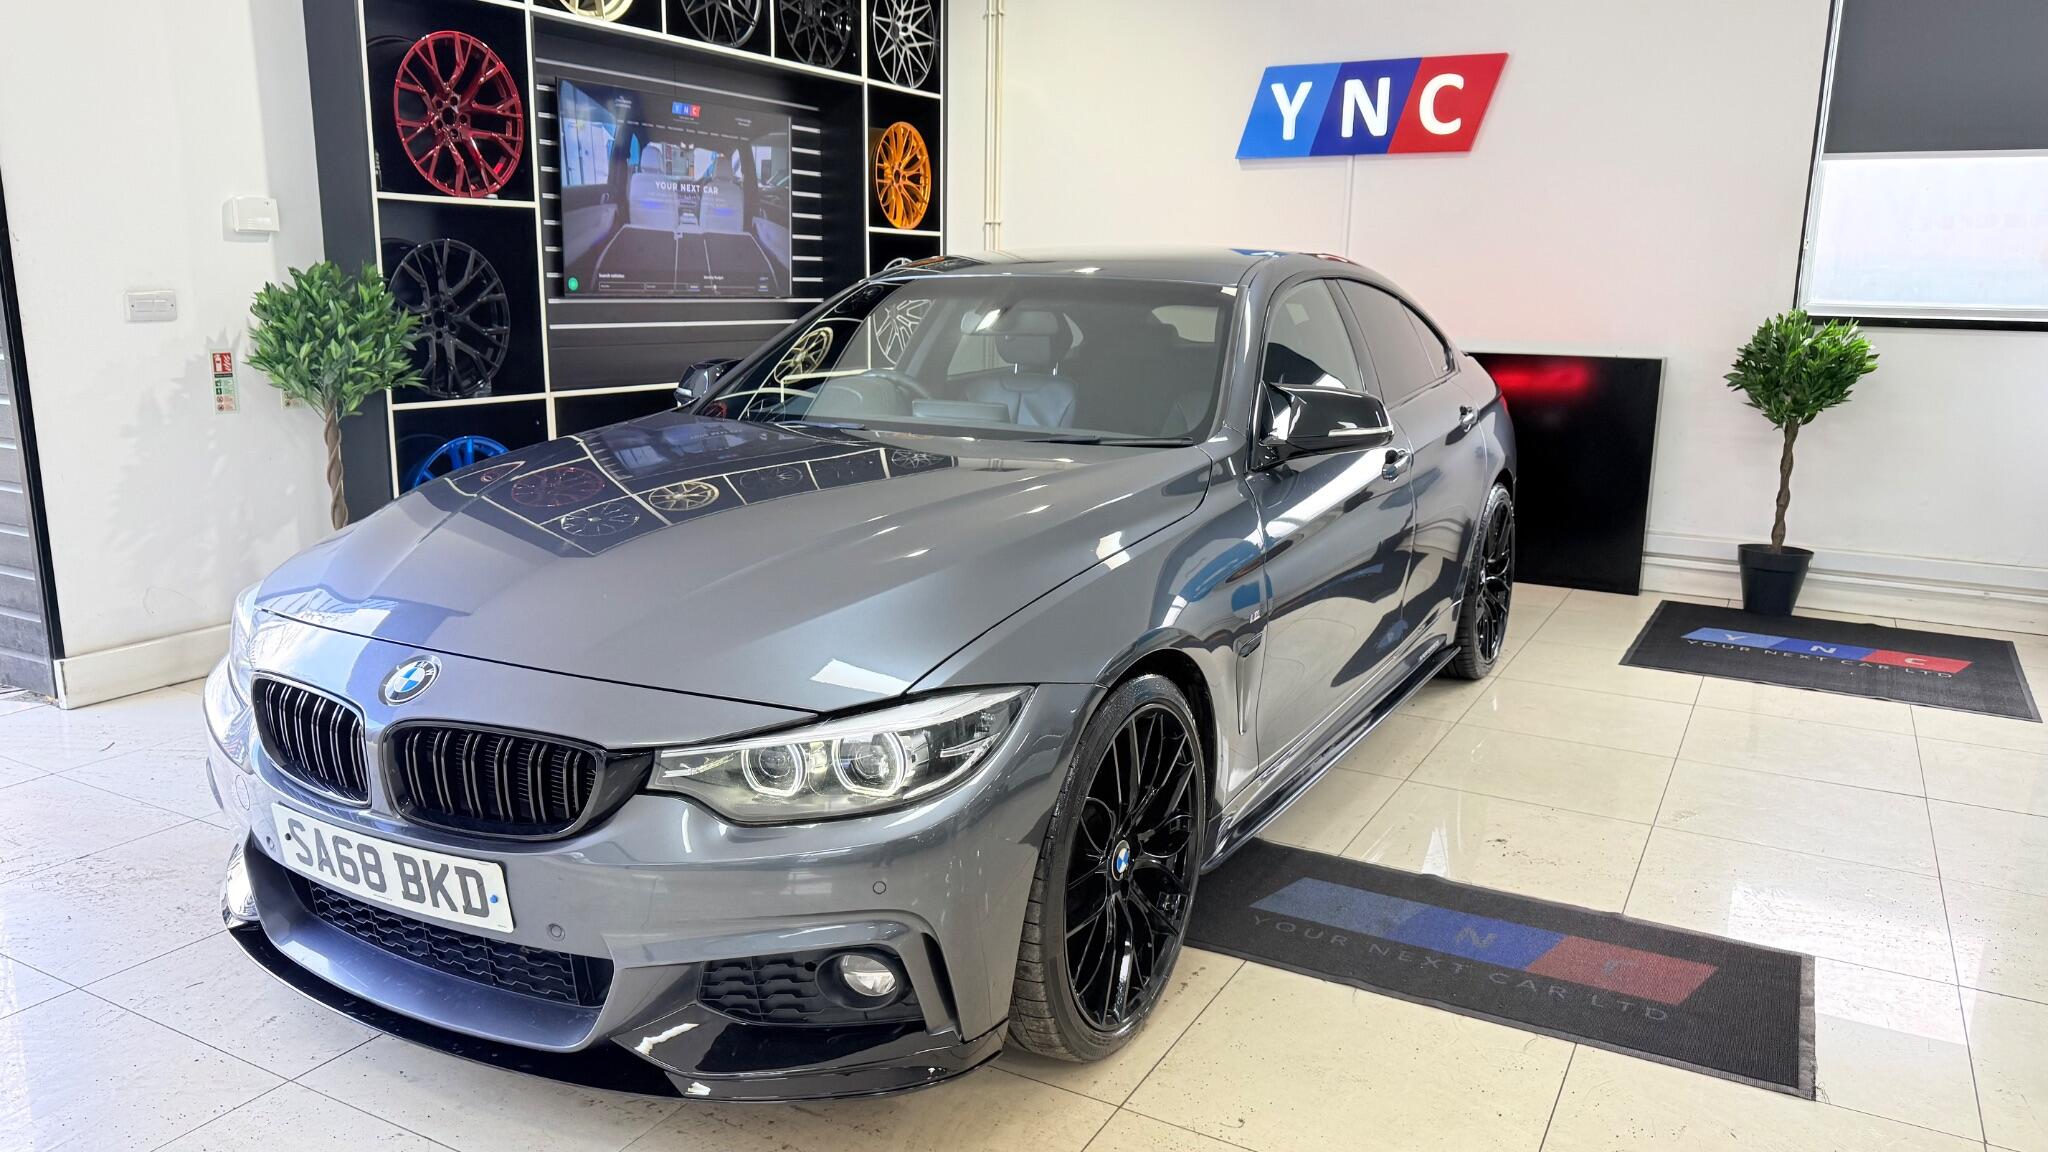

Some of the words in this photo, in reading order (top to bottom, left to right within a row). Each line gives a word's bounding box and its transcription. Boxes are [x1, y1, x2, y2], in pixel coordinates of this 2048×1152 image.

[675, 104, 697, 116] YNC
[1271, 73, 1464, 140] YNC
[656, 181, 678, 190] YOUR
[681, 184, 700, 193] NEXT
[703, 186, 719, 195] CAR
[1688, 640, 1750, 651] YOUR
[1765, 650, 1828, 661] NEXT
[1841, 660, 1889, 669] CAR
[1906, 668, 1952, 678] LTD
[1725, 634, 1926, 666] YNC
[287, 817, 387, 894] SA68
[392, 852, 491, 918] BKD
[1254, 915, 1348, 946] YOUR
[1369, 943, 1472, 974] NEXT
[1488, 972, 1569, 998] CAR
[1591, 994, 1668, 1021] LTD
